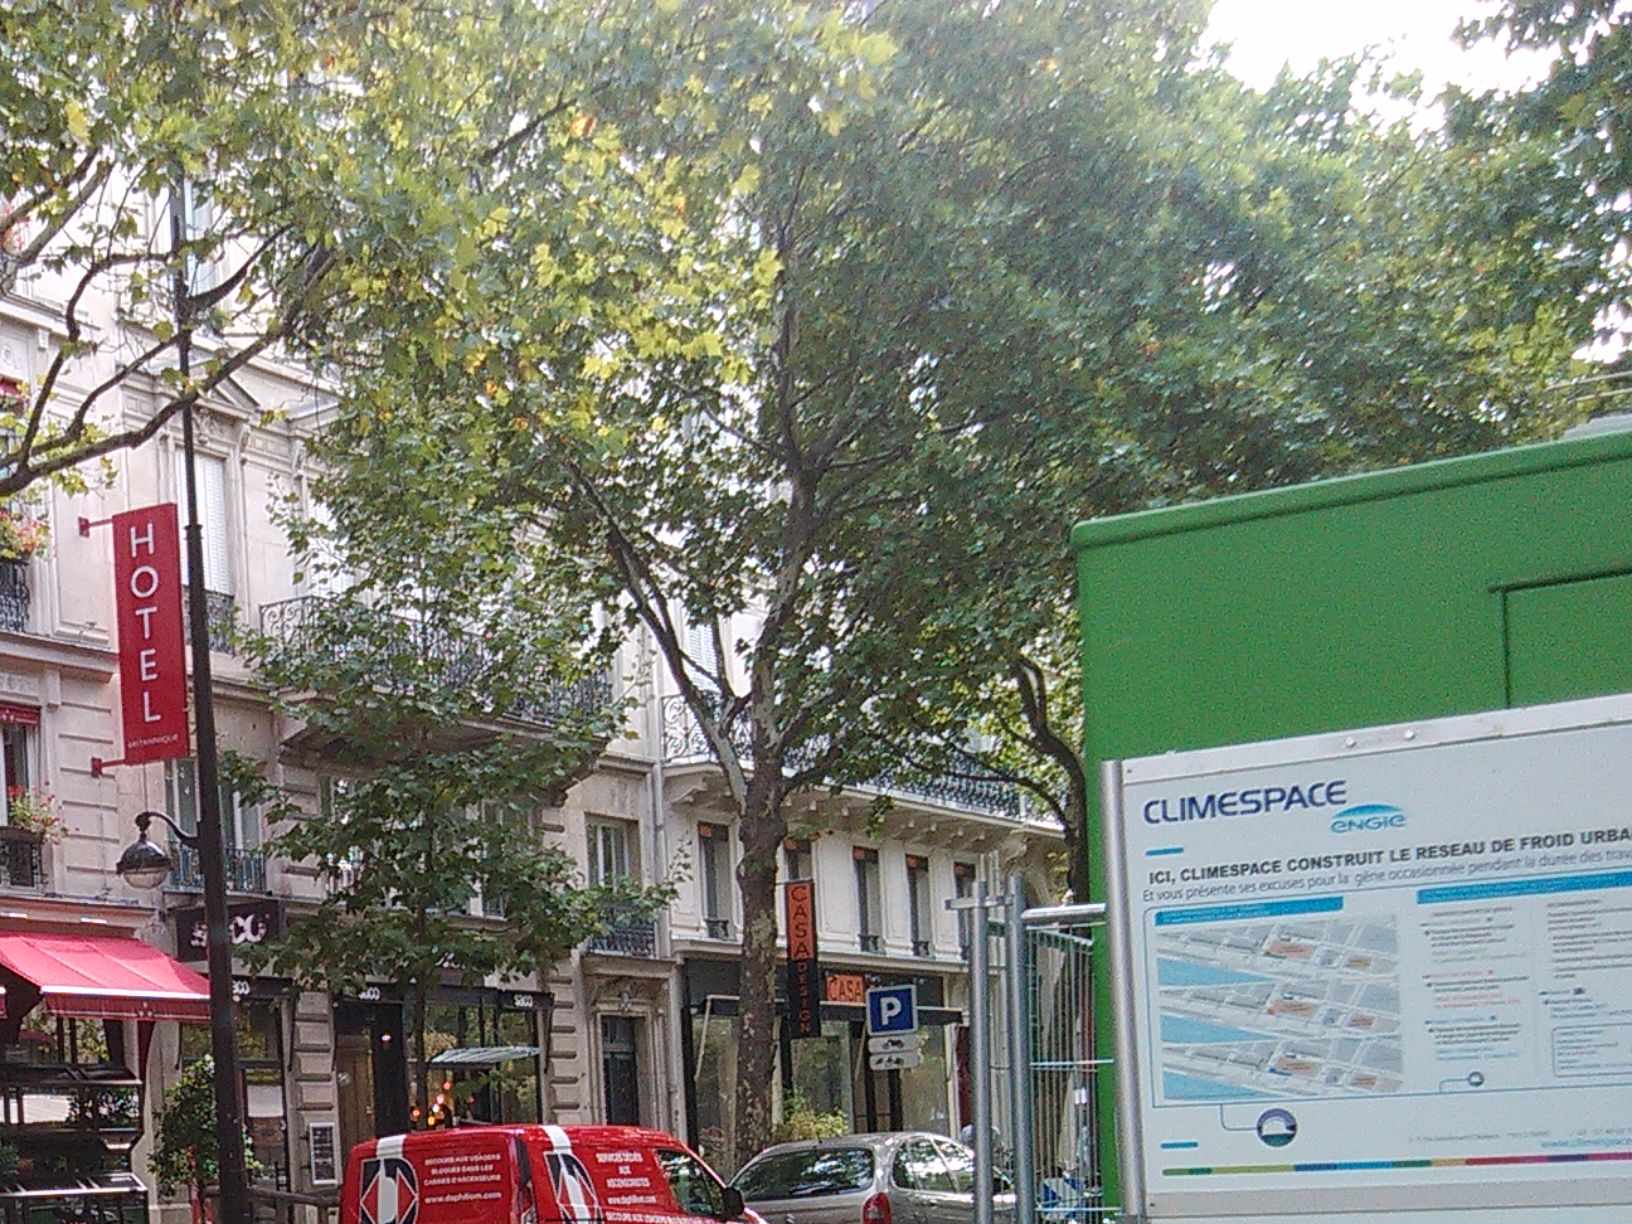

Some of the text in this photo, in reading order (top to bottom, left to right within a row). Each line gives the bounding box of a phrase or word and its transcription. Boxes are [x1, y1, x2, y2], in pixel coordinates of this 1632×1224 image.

[130, 521, 161, 723] HOTEL
[1143, 780, 1348, 825] CLIMESPACE
[1148, 870, 1176, 885] ICI,
[1180, 860, 1282, 881] CLIMESPACE
[1287, 850, 1384, 872] CONSTRUIT
[1389, 847, 1411, 862] LE
[1416, 841, 1486, 861] RESEAU
[1491, 837, 1516, 853] DE
[1519, 833, 1575, 850] FROID
[1157, 889, 1184, 901] vous
[1185, 884, 1237, 900] présente
[1259, 879, 1306, 893] excuses
[1308, 875, 1336, 891] pour
[1468, 857, 1521, 876] pendant
[791, 886, 810, 958] CASA
[797, 961, 810, 1033] DESIGN
[828, 977, 862, 1002] CASA
[880, 997, 902, 1026] P
